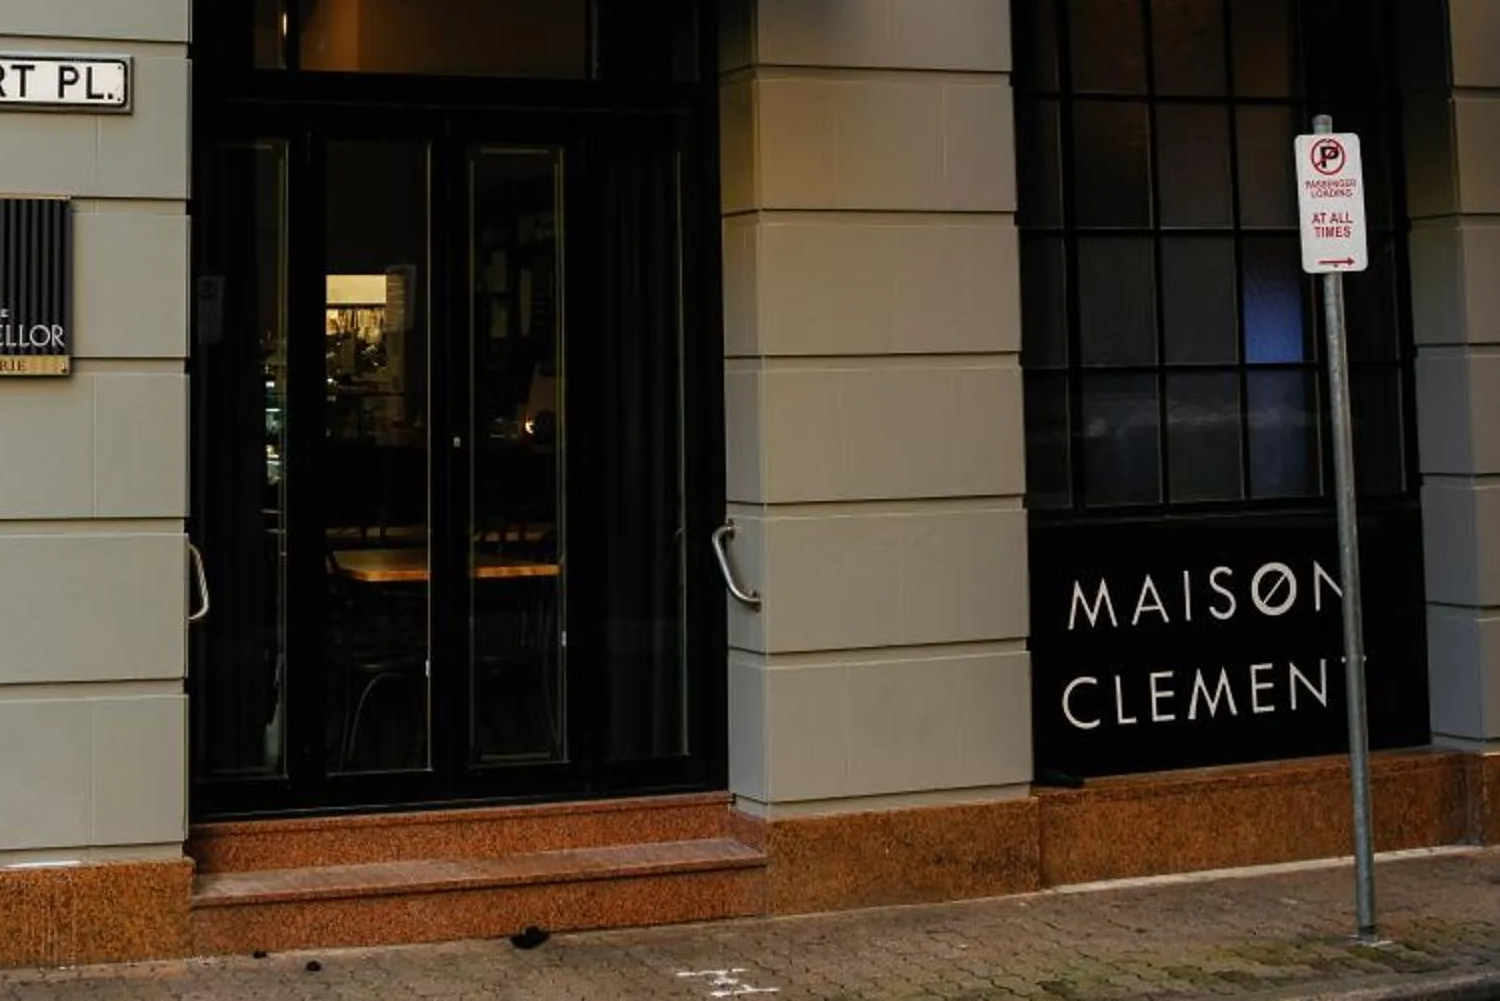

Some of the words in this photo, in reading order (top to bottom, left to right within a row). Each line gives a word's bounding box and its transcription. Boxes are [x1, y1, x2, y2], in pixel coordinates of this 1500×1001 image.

[58, 65, 114, 100] PL.
[1304, 179, 1357, 189] PASSENGER
[1311, 189, 1353, 198] LOADING
[1311, 212, 1326, 224] AT
[1329, 212, 1353, 224] ALL
[1314, 226, 1351, 238] TIMES
[1062, 655, 1367, 729] CLEMEN
